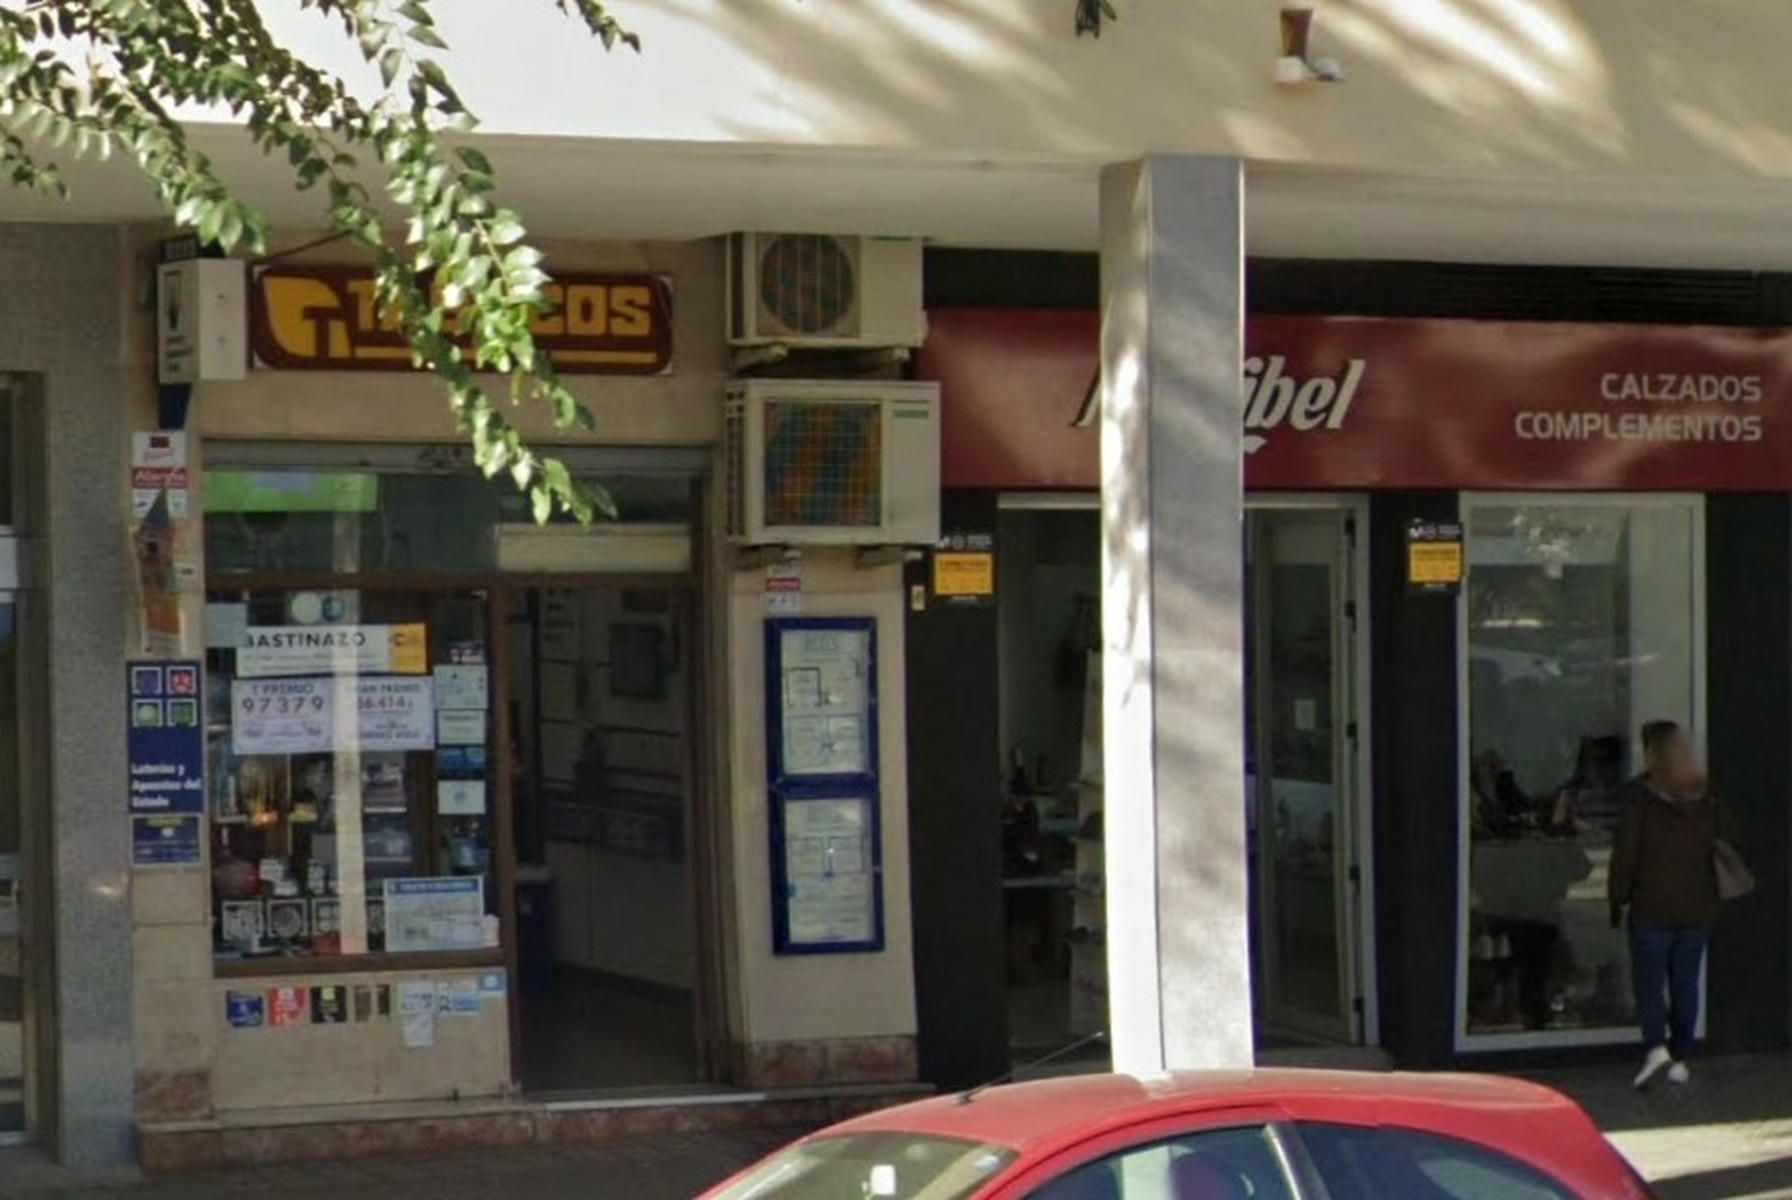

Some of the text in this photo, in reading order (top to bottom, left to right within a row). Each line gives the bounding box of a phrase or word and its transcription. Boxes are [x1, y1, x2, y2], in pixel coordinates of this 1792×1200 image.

[1601, 373, 1762, 401] CALZADOS
[1515, 412, 1762, 441] COMPLEMENTOS
[242, 696, 324, 713] 97379
